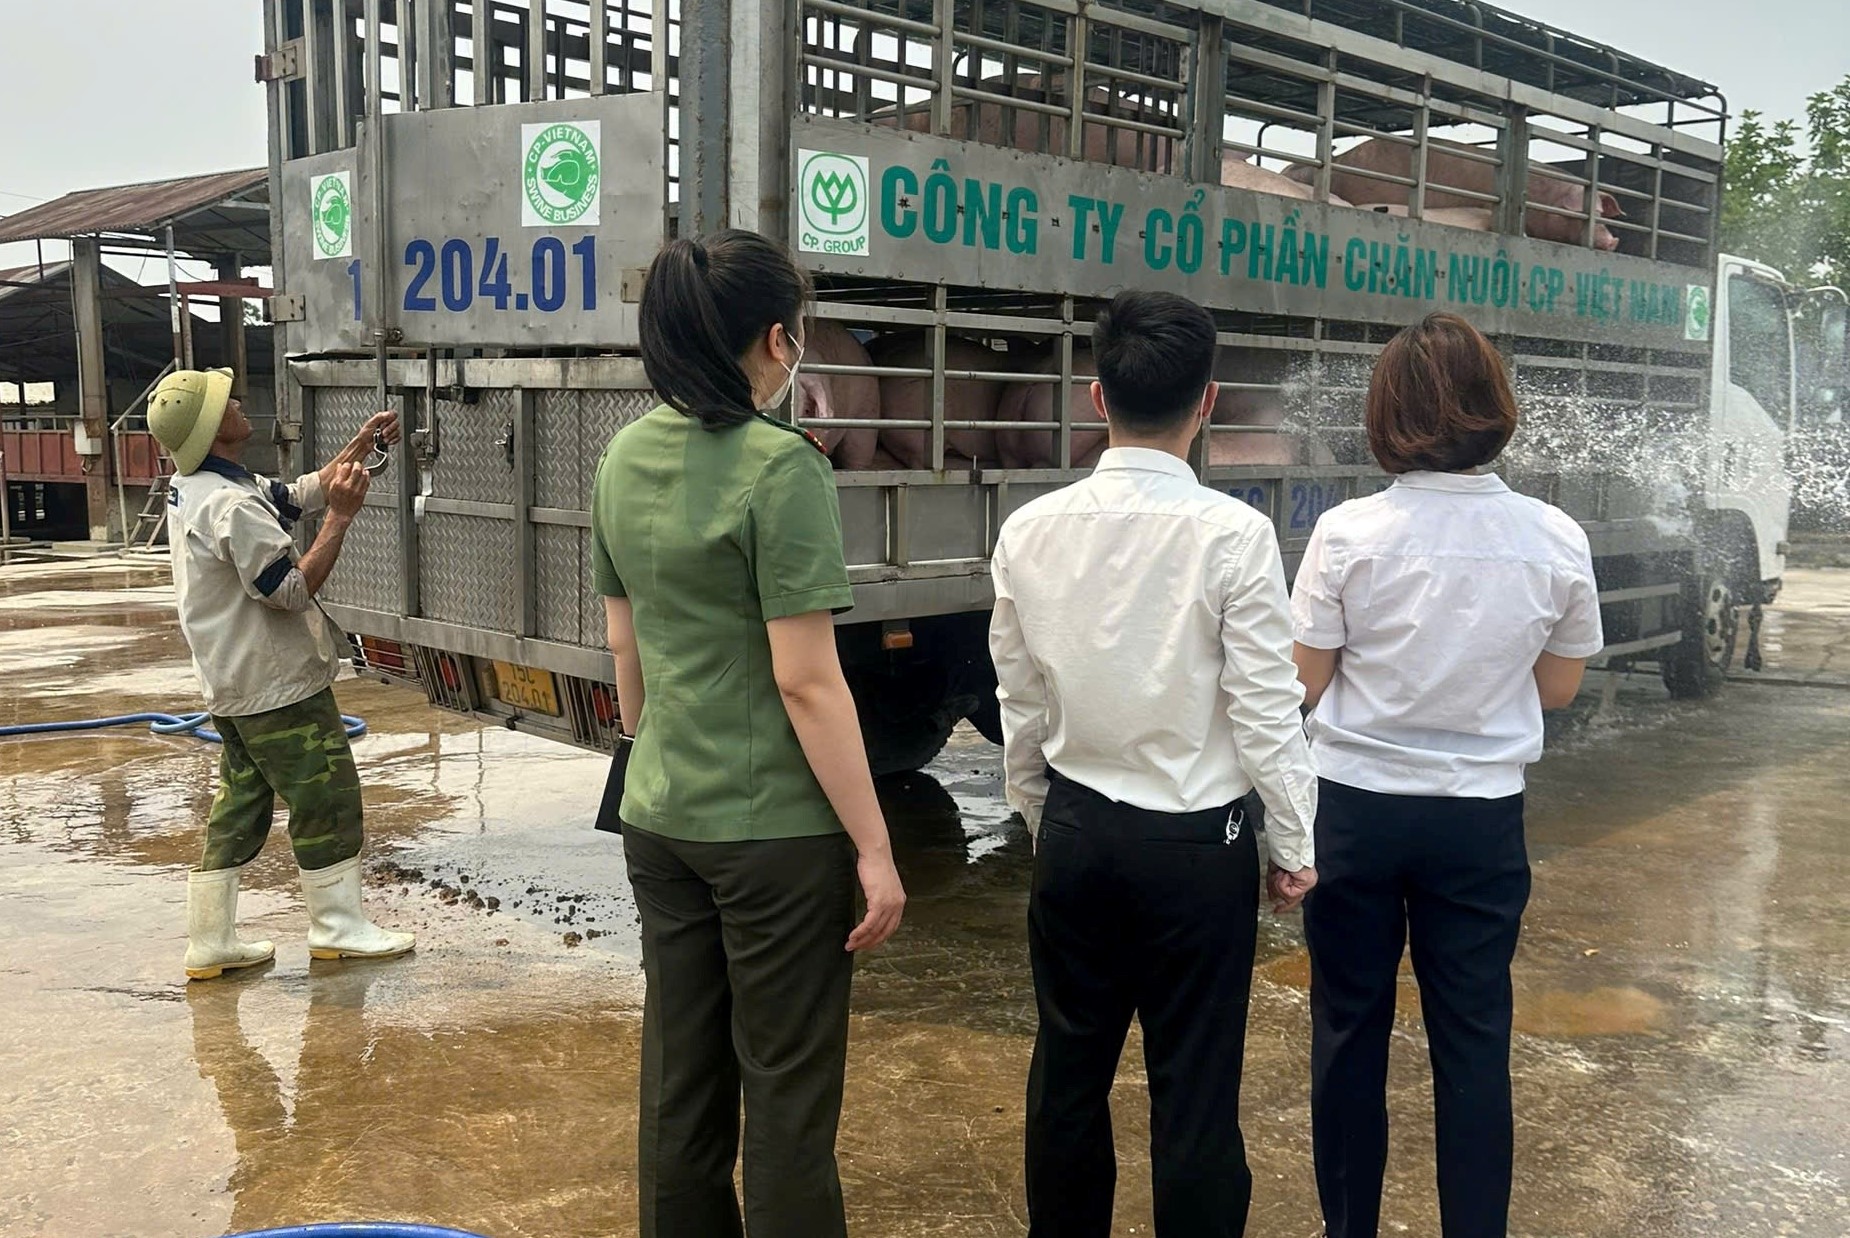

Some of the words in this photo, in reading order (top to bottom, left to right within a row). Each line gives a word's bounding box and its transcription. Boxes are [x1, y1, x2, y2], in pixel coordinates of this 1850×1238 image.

[529, 126, 597, 165] CP-VIETNAM
[553, 174, 598, 221] BUSINESS
[823, 235, 866, 254] GROUP
[881, 158, 1038, 255] CÔNG
[1068, 195, 1125, 264] TY
[1144, 189, 1205, 274] CỔ
[1220, 208, 1329, 290] PHẦN
[1344, 233, 1437, 300] CHĂN
[1447, 247, 1521, 310] NUÔI
[1529, 264, 1565, 313] CP
[1576, 267, 1624, 326] VIỆT
[1630, 279, 1680, 326] NAM
[403, 235, 597, 312] 204.01
